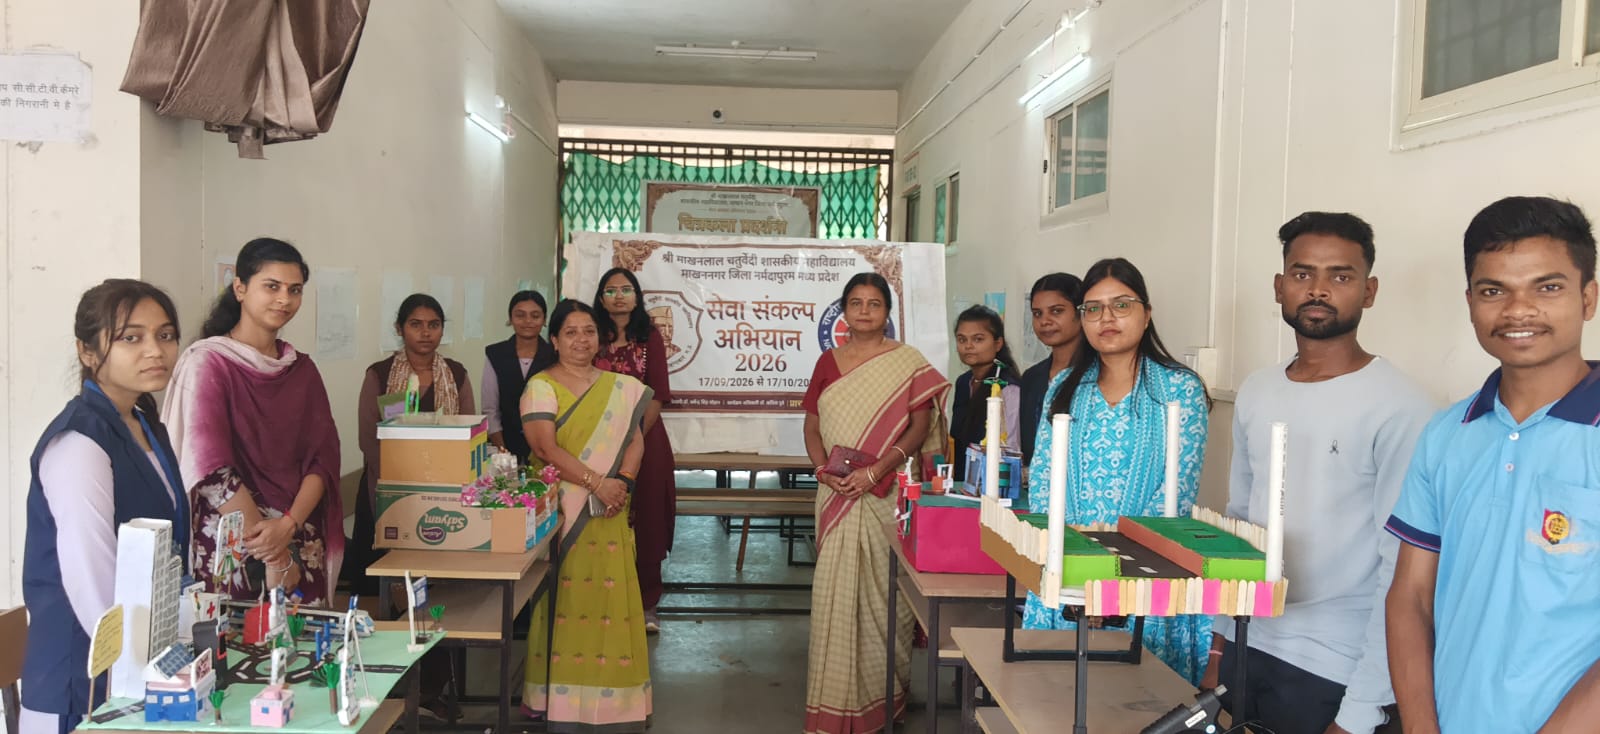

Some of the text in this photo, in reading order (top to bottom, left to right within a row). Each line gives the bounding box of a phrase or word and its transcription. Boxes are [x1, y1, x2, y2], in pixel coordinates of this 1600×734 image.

[16, 97, 49, 109] निगरानी
[678, 212, 788, 235] चित्रकला प्रदर्शनी
[662, 251, 674, 263] श्री
[677, 255, 724, 266] माखनलाल
[727, 252, 758, 269] चतुर्वेदी
[761, 254, 799, 267] शासकीय
[681, 268, 840, 284] माखननगर जिला नर्मदापुरम मध्य प्रदेश
[705, 293, 746, 320] सेवा
[752, 295, 816, 322] संकल्प
[714, 322, 802, 351] अभियान
[735, 353, 787, 372] 2026
[699, 377, 754, 387] 17/09/2026
[757, 376, 764, 386] से
[425, 514, 466, 529] Satyam
